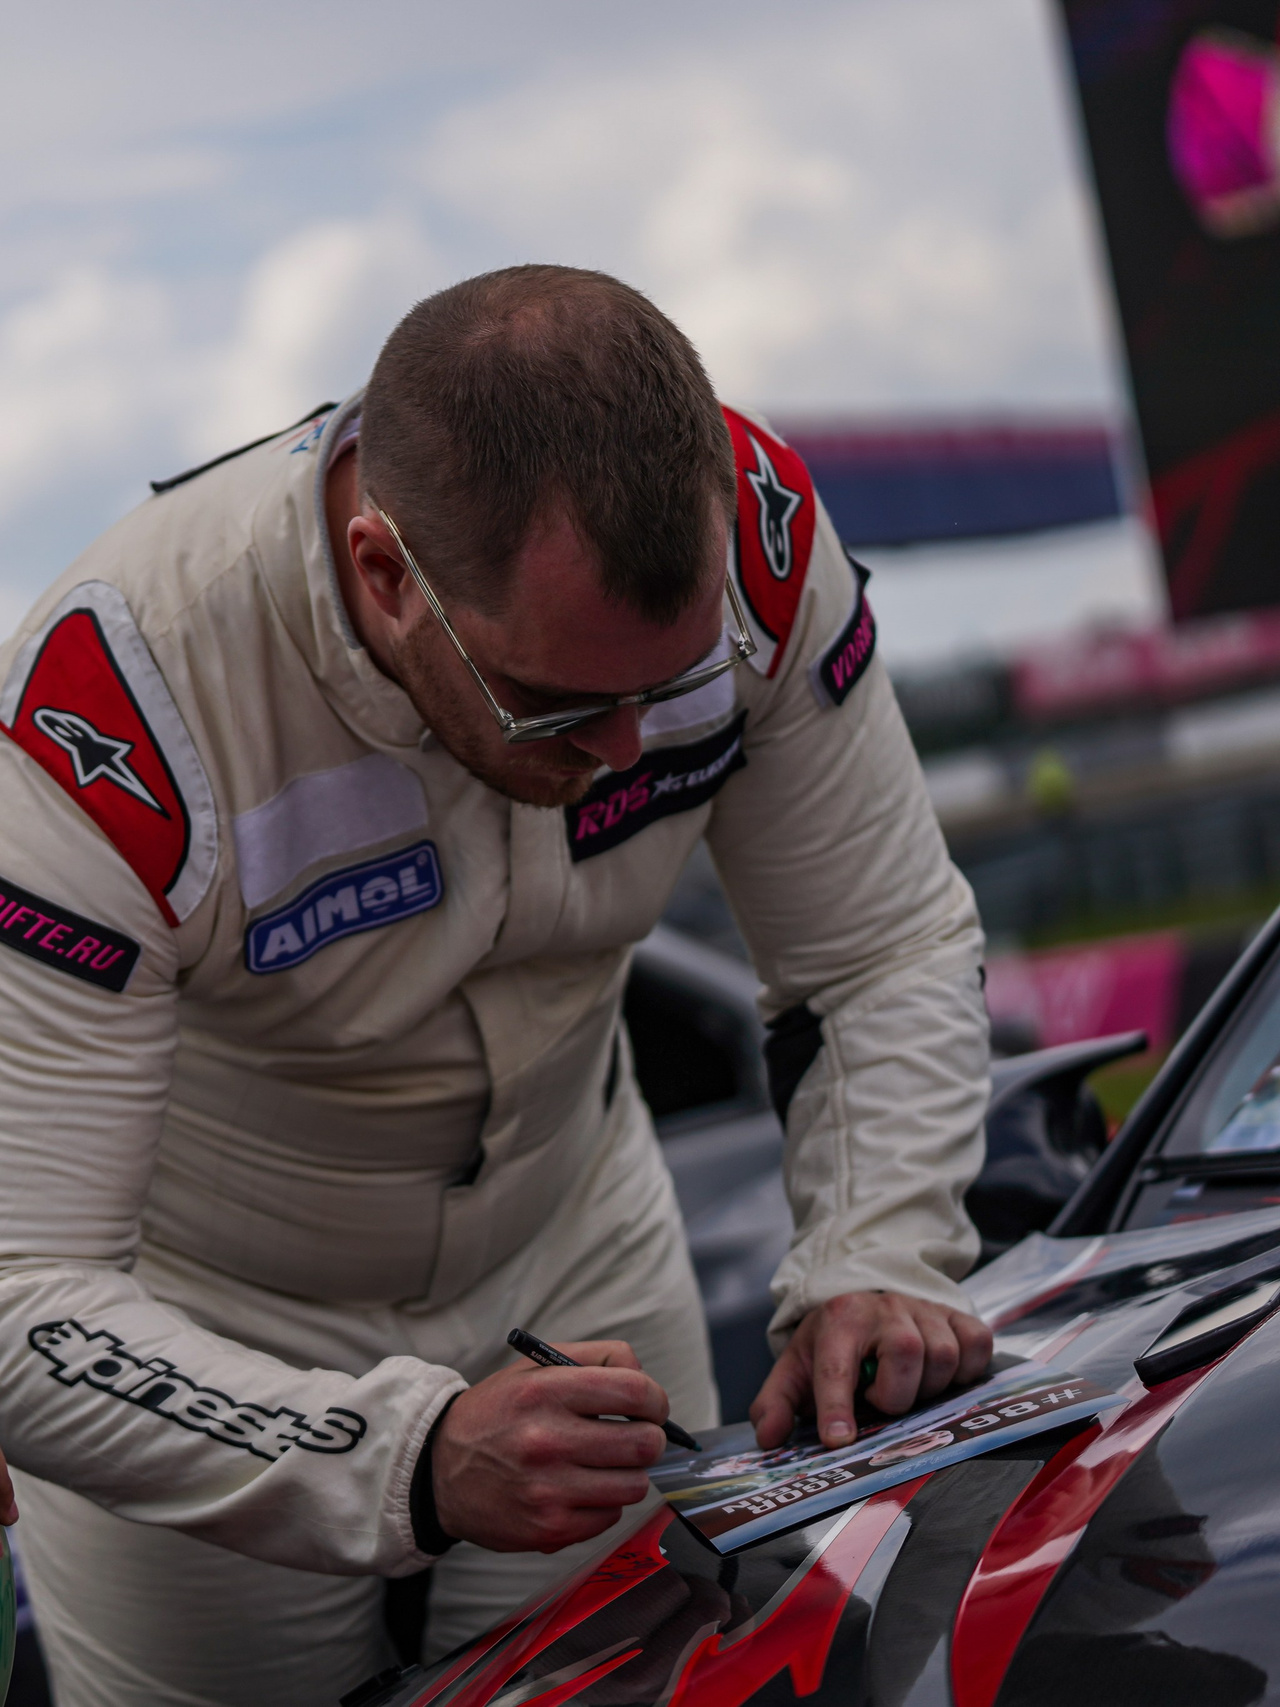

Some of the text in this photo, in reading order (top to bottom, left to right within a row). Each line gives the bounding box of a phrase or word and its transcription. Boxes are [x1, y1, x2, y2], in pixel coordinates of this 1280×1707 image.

[575, 771, 654, 841] RDS
[259, 864, 434, 965] AIMOL
[960, 1388, 1083, 1430] #86
[747, 1470, 856, 1514] EGOR
